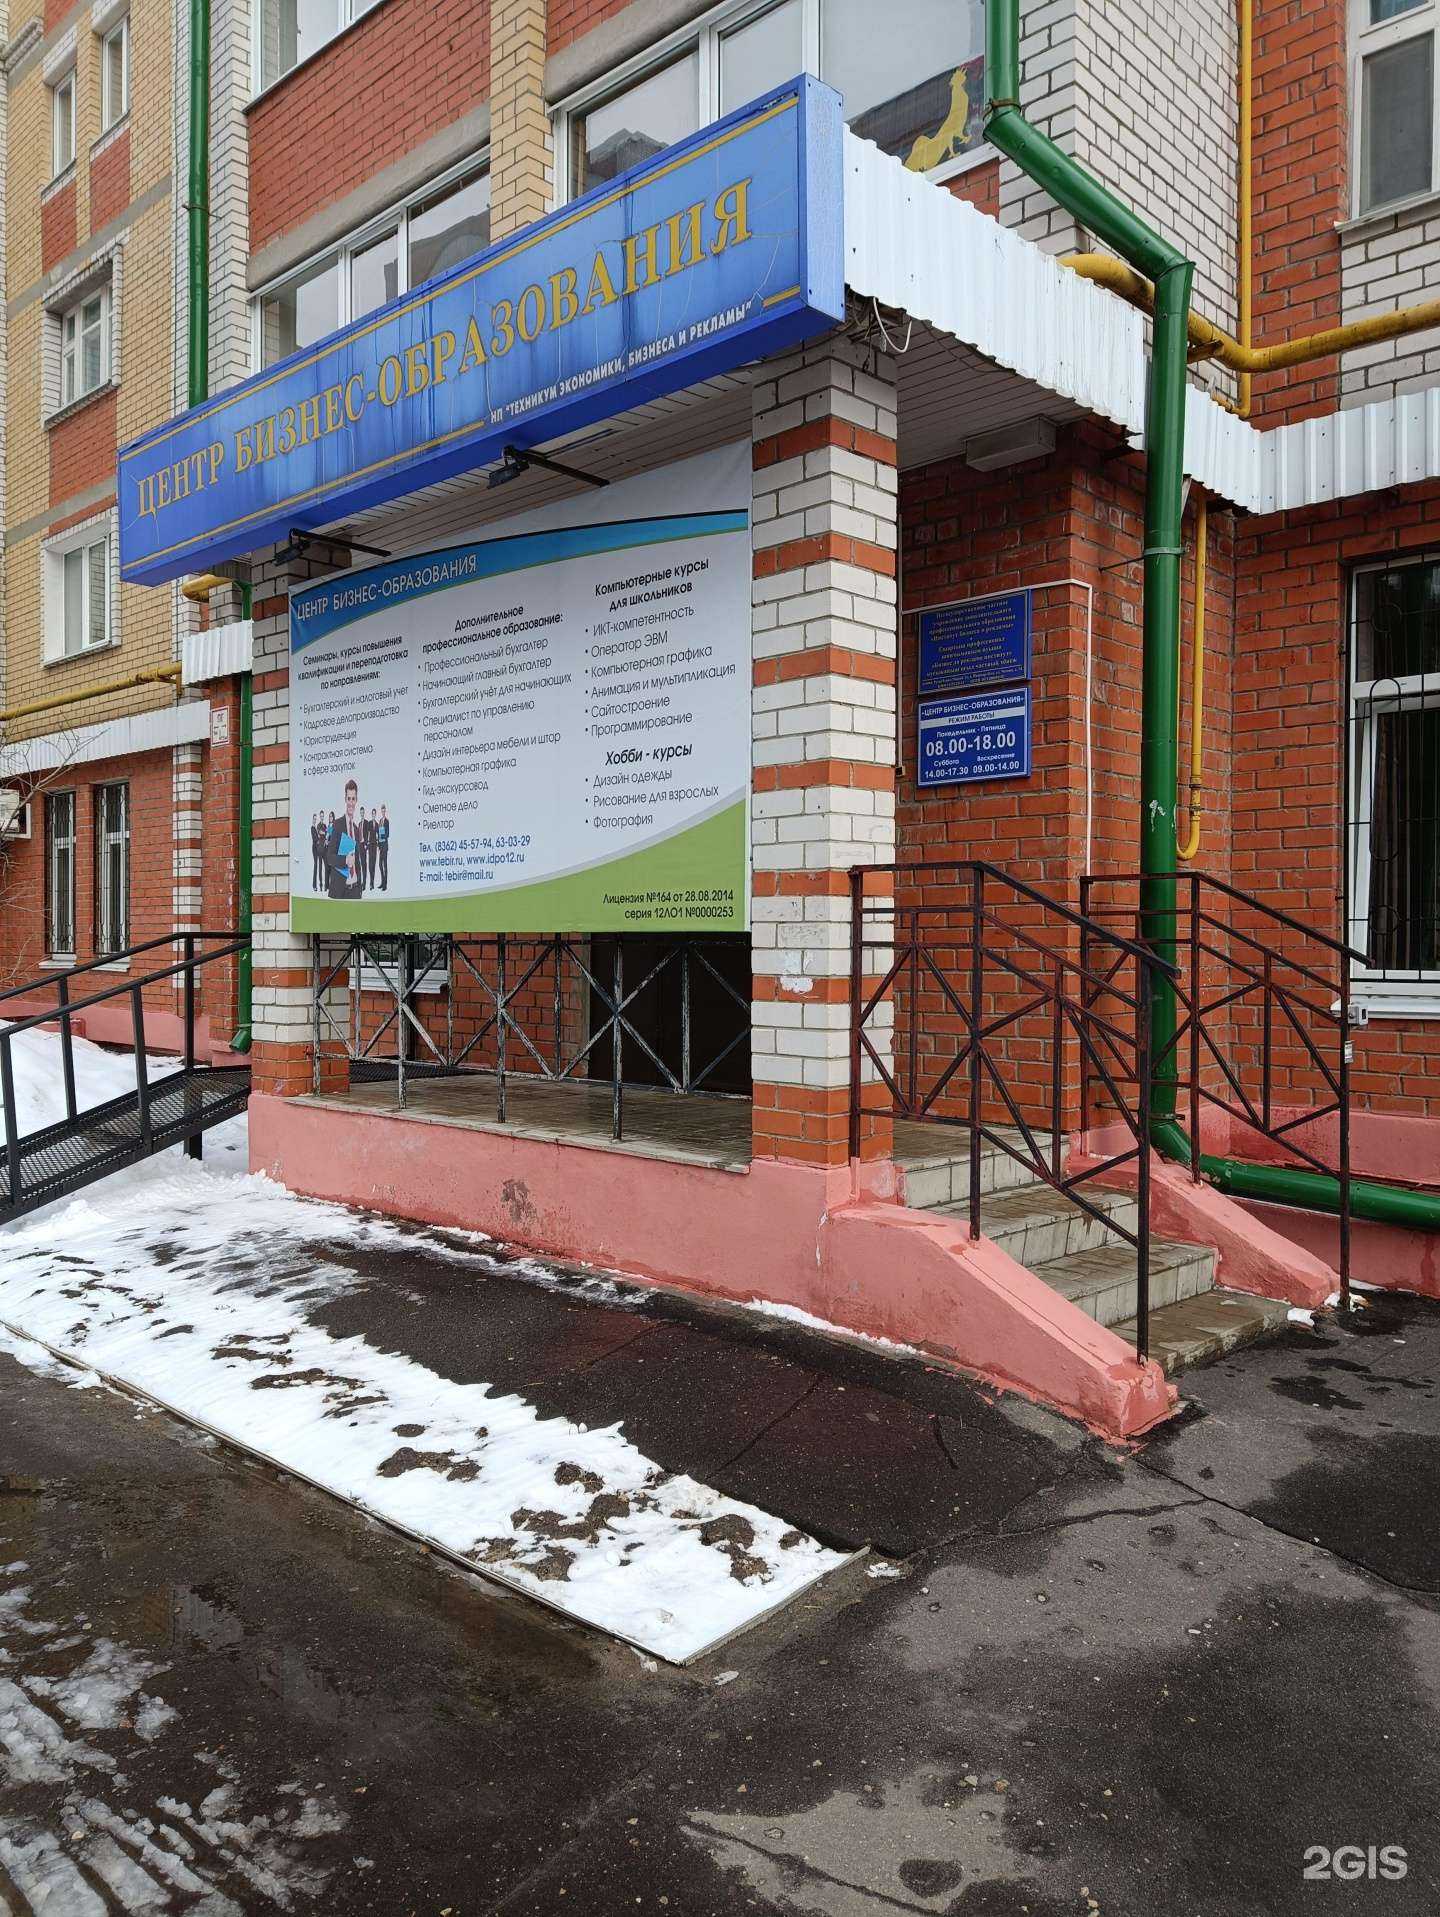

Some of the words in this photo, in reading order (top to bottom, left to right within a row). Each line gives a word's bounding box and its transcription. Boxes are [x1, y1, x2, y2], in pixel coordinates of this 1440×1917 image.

[137, 445, 225, 519] ЦЕНТР
[233, 177, 753, 473] БИЗНЕС-ОБРАЗОВАНИЯ
[490, 408, 503, 424] НП
[559, 357, 625, 397] ЭКОНОМИКИ,
[628, 334, 675, 367] БИЗНЕСА
[678, 328, 686, 346] И
[297, 597, 328, 622] ЦЕНТР
[333, 554, 477, 610] БИЗНЕС-ОБРАЗОВАНИЯ
[595, 568, 672, 597] Компьютерные
[674, 558, 709, 578] курсы
[609, 599, 628, 613] для
[629, 582, 693, 606] школьников
[454, 606, 524, 633] Дополнительное
[593, 605, 695, 637] ИКТ-компетентность
[422, 626, 501, 654] профессиональное
[503, 613, 563, 636] образование:
[591, 638, 642, 658] Оператор
[644, 630, 668, 647] ЭВМ
[340, 645, 362, 659] курсы
[362, 636, 403, 653] повышения
[424, 646, 503, 673] Профессиональный
[505, 637, 548, 657] бухгалтер
[298, 664, 345, 681] квалификации
[346, 660, 351, 670] и
[351, 649, 409, 671] переподготовка
[591, 655, 665, 678] Компьютерная
[666, 645, 712, 665] графика
[321, 681, 329, 690] по
[330, 671, 381, 688] направлениям:
[423, 671, 474, 691] Начинающий
[475, 665, 507, 681] главный
[508, 657, 552, 675] бухгалтер
[591, 680, 641, 699] Анимация
[642, 680, 649, 690] и
[651, 664, 736, 690] мультипликация
[303, 697, 350, 715] Бухгалтерский
[356, 688, 392, 704] налоговый
[423, 689, 479, 710] Бухгалтерский
[499, 684, 514, 696] для
[515, 673, 572, 691] начинающих
[423, 710, 470, 727] Специалист
[470, 707, 481, 719] по
[482, 700, 535, 718] управлению
[591, 696, 671, 718] Сайтостроение
[303, 717, 336, 731] Кадровое
[336, 706, 400, 725] делопроизводство
[591, 712, 693, 739] Программирование
[948, 713, 971, 724] РЕЖИМ
[303, 731, 357, 747] Юриспруденция
[424, 726, 473, 743] персоналом
[936, 727, 976, 738] Понедельник
[980, 724, 1006, 733] Пятница
[303, 748, 343, 763] Контрактная
[344, 744, 373, 757] система
[423, 746, 451, 761] Дизайн
[452, 741, 496, 757] интерьера
[496, 736, 529, 751] мебели
[530, 734, 537, 744] и
[538, 732, 561, 745] штор
[605, 748, 643, 766] Хобби
[652, 744, 692, 762] курсы
[926, 731, 1016, 757] 08.00-18.00
[308, 764, 329, 777] сфере
[329, 761, 355, 775] закупок
[423, 763, 480, 778] Компьютерная
[481, 757, 517, 772] графика
[925, 765, 969, 779] 14.00-17.30
[972, 760, 1020, 774] 09.00-14.00
[933, 758, 960, 768] Суббота
[423, 780, 488, 797] Гид-экскурсовод
[593, 772, 630, 789] Дизайн
[631, 769, 673, 784] одежды
[423, 802, 457, 814] Сметное
[457, 800, 478, 813] дело
[593, 791, 647, 807] Рисование
[648, 790, 667, 803] для
[668, 786, 719, 801] взрослых
[423, 818, 455, 832] Риелтор
[593, 813, 653, 829] Фотография
[434, 839, 458, 854] (8362)
[458, 837, 494, 851] 45-57-94,
[495, 834, 531, 848] 63-03-29
[419, 856, 466, 868] www.tebir.ru,
[466, 852, 525, 867] www.idpo12.ru
[419, 869, 444, 882] E-mail:
[445, 868, 494, 881] tebir@mail.ru
[603, 893, 645, 905] Лицензия
[646, 891, 671, 903] №164
[673, 892, 683, 902] от
[685, 889, 734, 902] 28.08.2014
[624, 909, 652, 920] серия
[685, 906, 734, 918] №0000253
